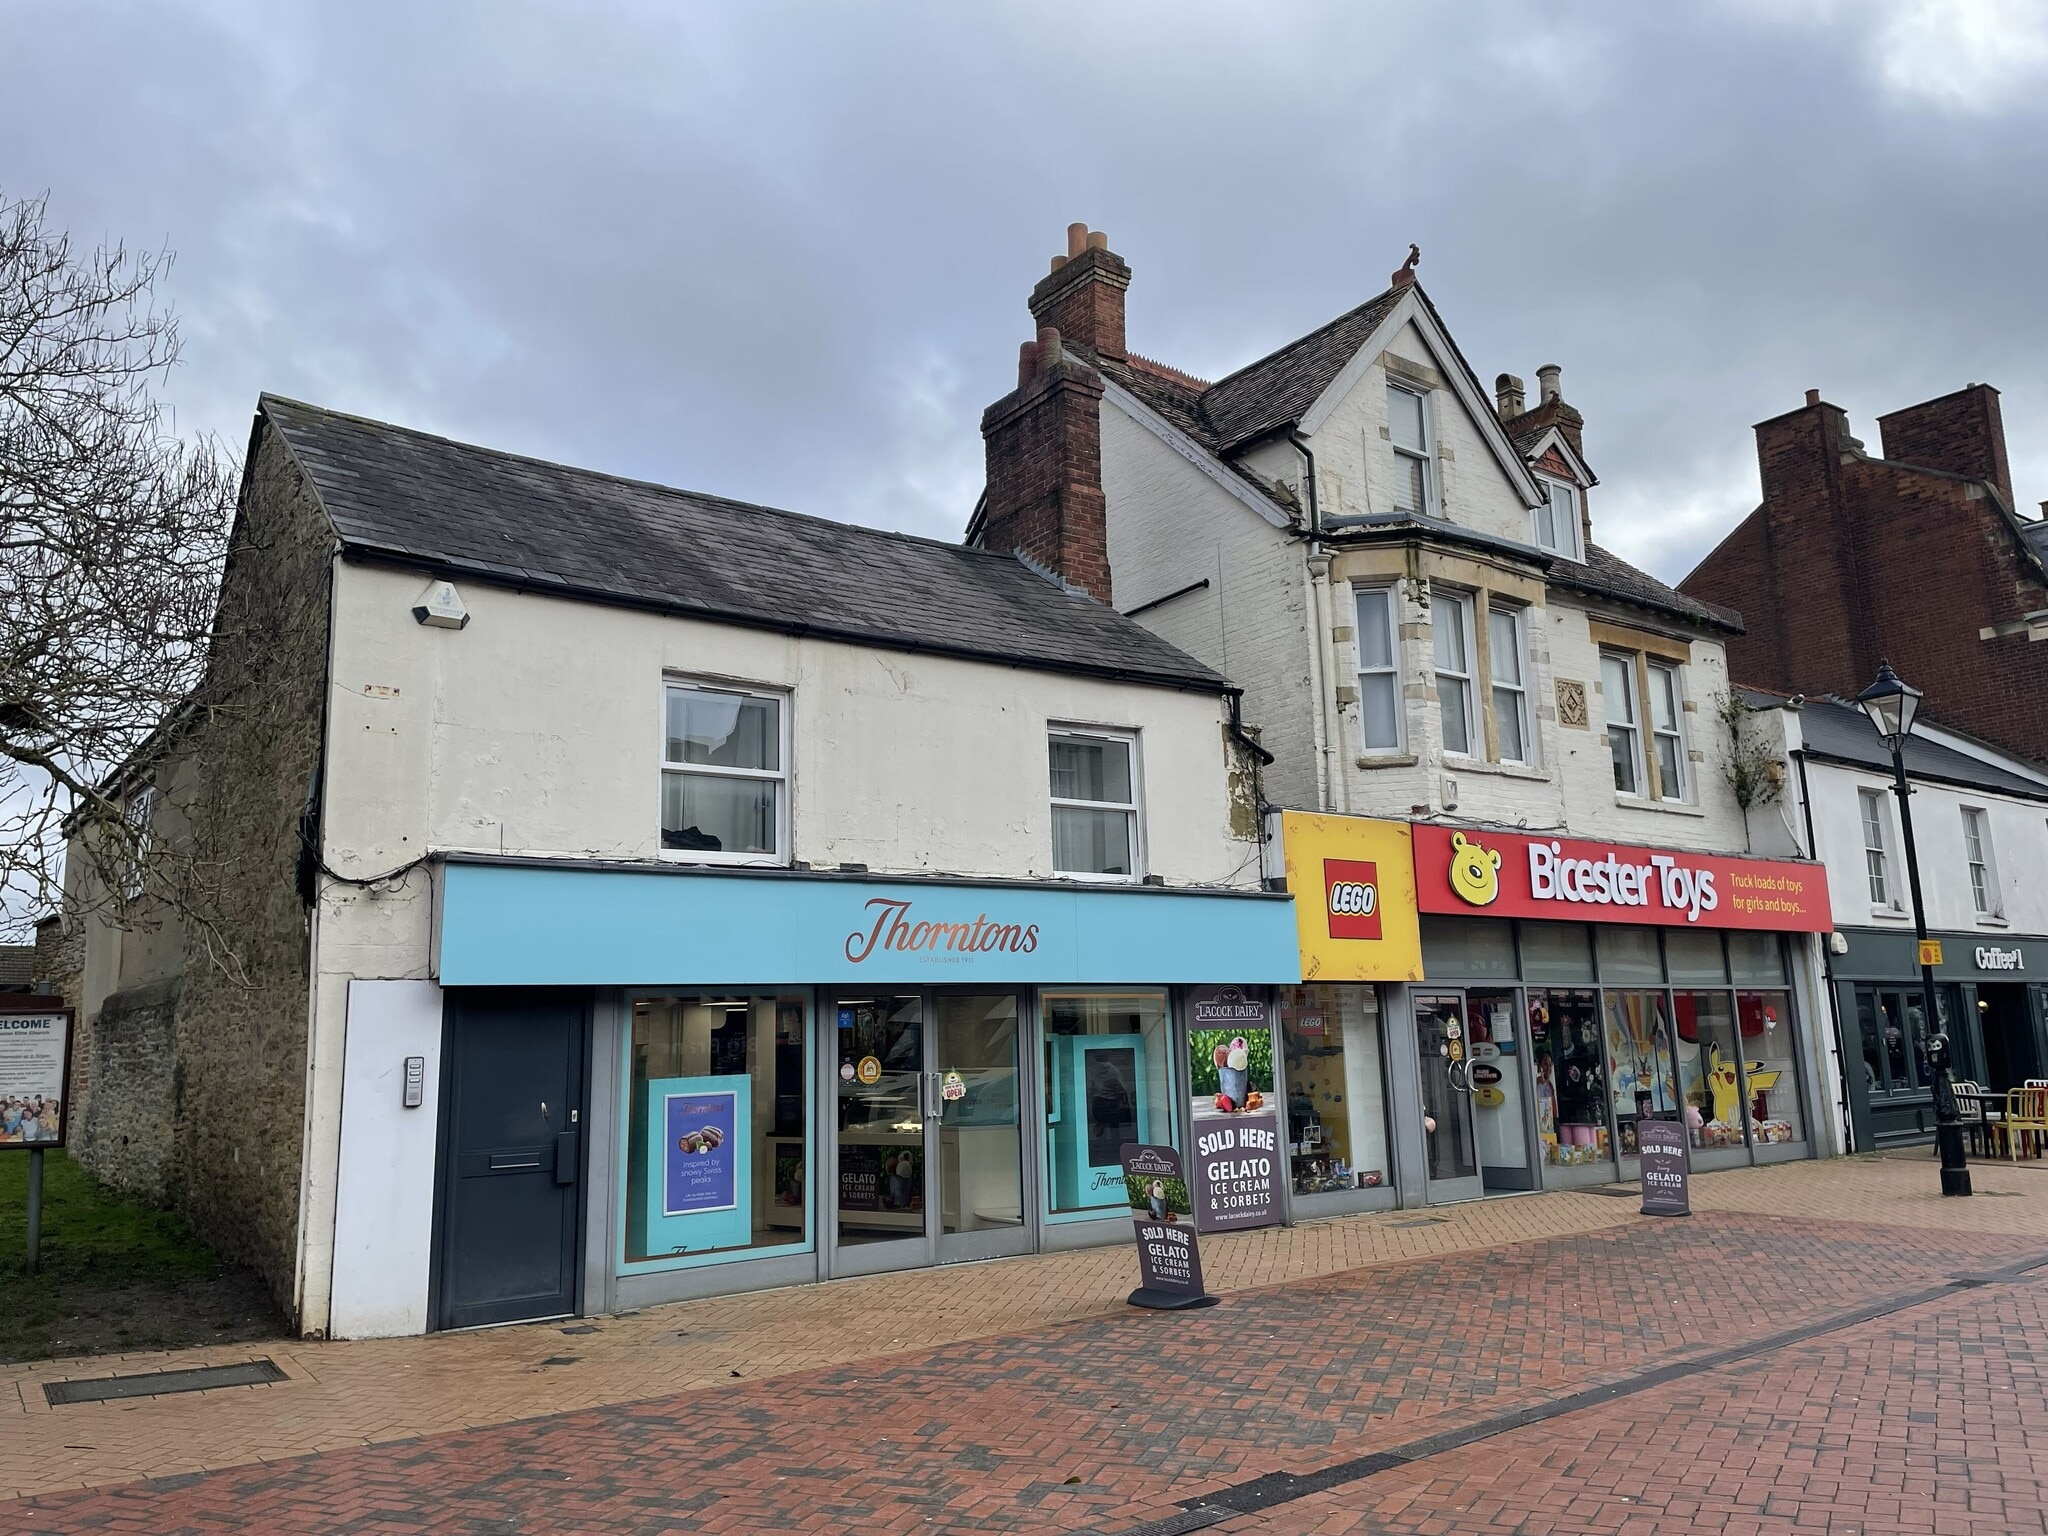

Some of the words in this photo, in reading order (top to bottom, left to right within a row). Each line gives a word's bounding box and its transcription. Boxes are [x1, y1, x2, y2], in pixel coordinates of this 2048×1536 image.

[1528, 841, 1652, 906] Bicester
[1651, 855, 1718, 922] Toys
[1730, 873, 1753, 888] Truck
[1754, 874, 1776, 890] loads
[1777, 876, 1785, 891] of
[1787, 880, 1803, 896] toys
[1331, 883, 1376, 915] LEGO
[1733, 894, 1745, 909] for
[1746, 895, 1764, 914] girls
[1765, 898, 1780, 911] and
[1781, 898, 1807, 916] boys...
[845, 897, 1040, 963] Thorntons
[920, 956, 960, 964] ESTABLISHED
[1200, 1005, 1233, 1017] LACOCK
[1235, 1005, 1260, 1017] DAIRY
[1300, 1017, 1321, 1027] LEGO
[1199, 1129, 1235, 1156] SOLD
[1240, 1128, 1275, 1151] HERE
[1641, 1145, 1660, 1155] SOLD
[1663, 1145, 1683, 1157] HERE
[683, 1160, 710, 1168] Inspired
[1207, 1158, 1271, 1181] GELATO
[704, 1167, 722, 1175] Swiss
[1646, 1172, 1682, 1182] GELATO
[691, 1176, 711, 1185] peaks
[842, 1173, 876, 1184] GELATO
[1211, 1182, 1228, 1195] ICE
[1233, 1179, 1270, 1192] CREAM
[849, 1192, 875, 1200] SORBETS
[1211, 1198, 1218, 1210] &
[1224, 1192, 1271, 1209] SORBETS
[1215, 1209, 1267, 1221] www.lacockdairy.co.uk
[1142, 1227, 1164, 1241] SOLD
[1166, 1227, 1189, 1246] HERE
[1148, 1243, 1189, 1260] GELATO
[1151, 1256, 1163, 1265] ICE
[1164, 1258, 1190, 1269] CREAM
[1152, 1265, 1157, 1273] &
[1160, 1265, 1191, 1278] SORBETS
